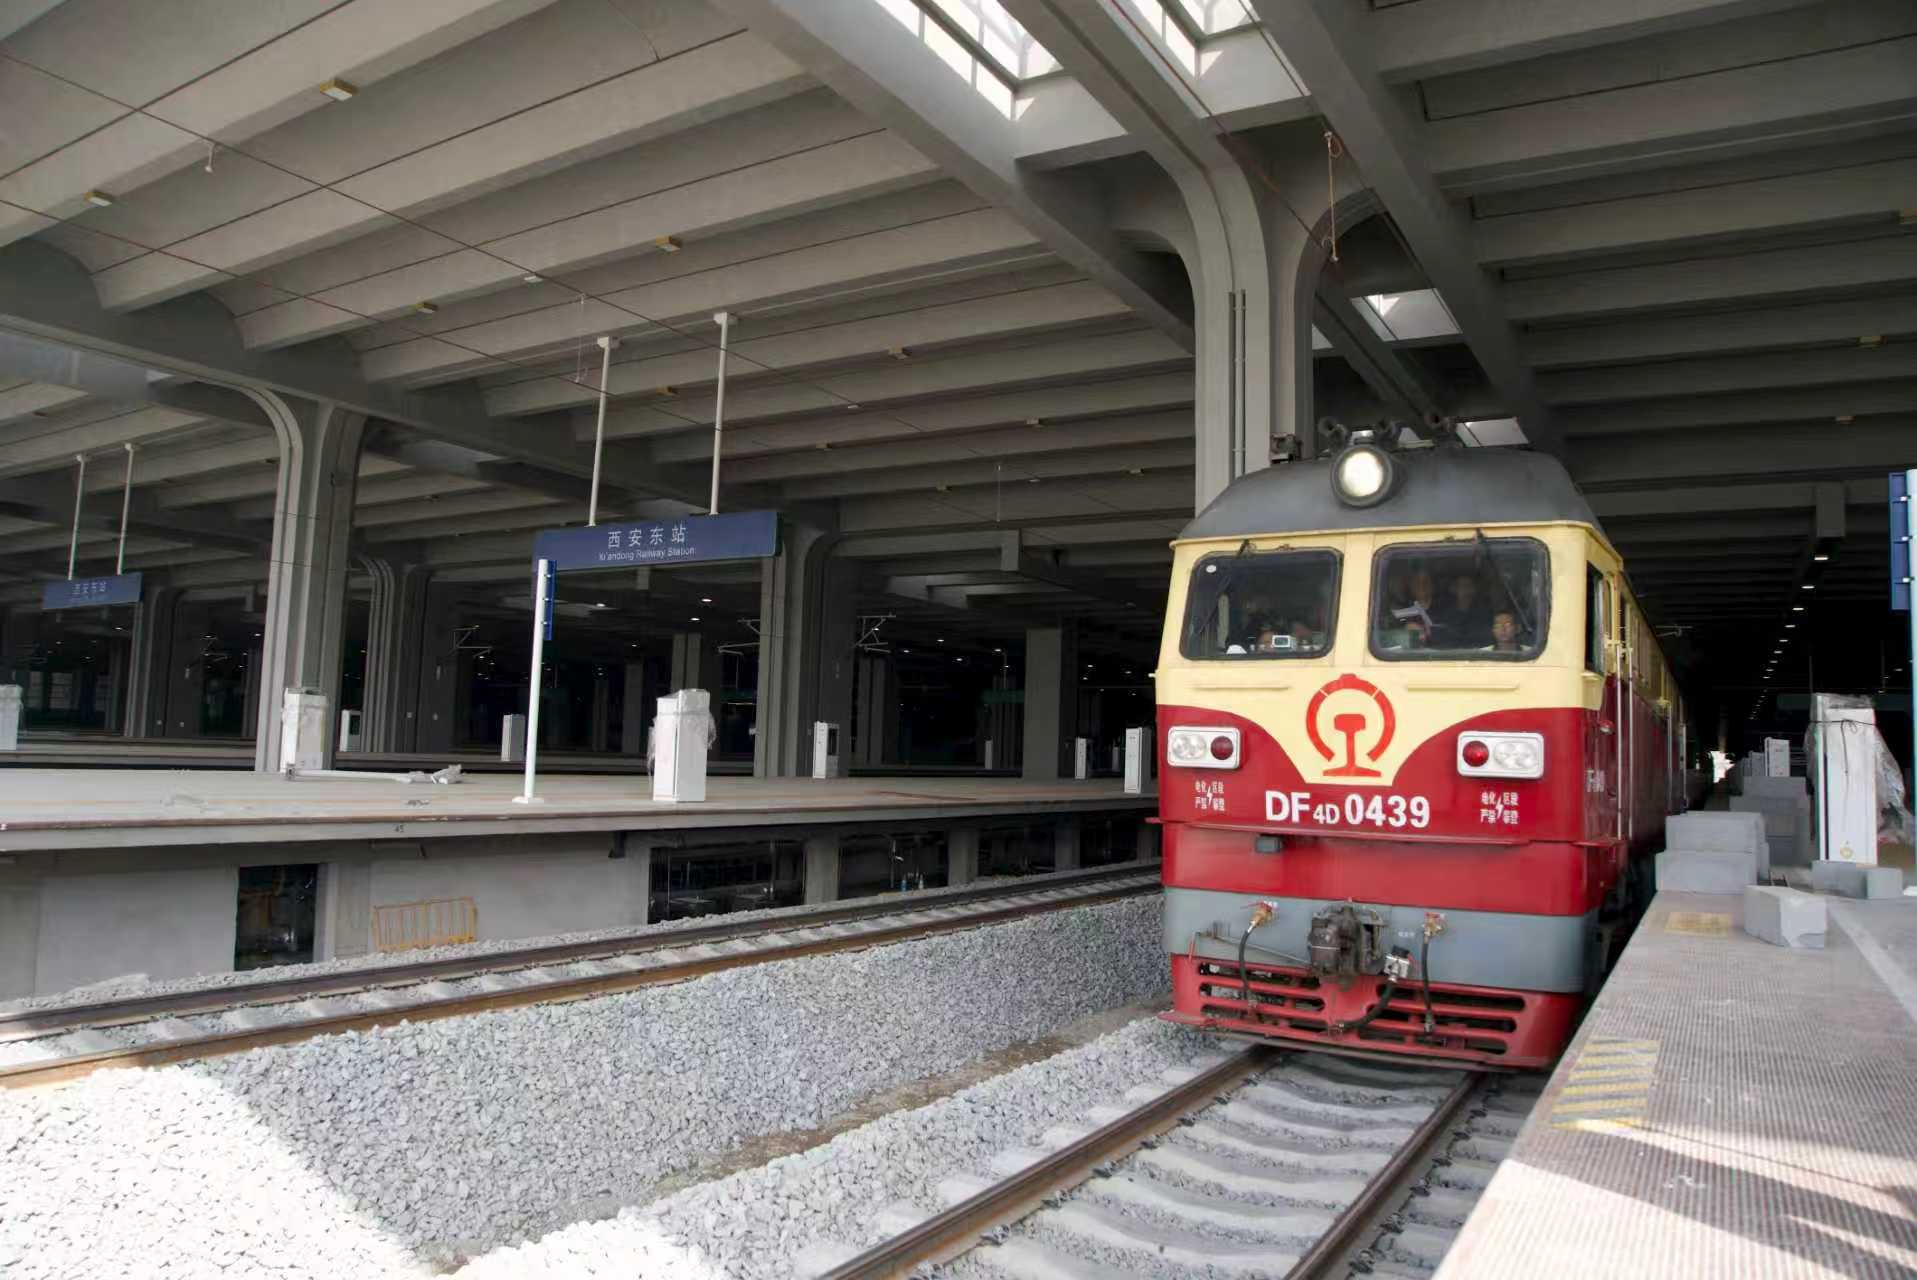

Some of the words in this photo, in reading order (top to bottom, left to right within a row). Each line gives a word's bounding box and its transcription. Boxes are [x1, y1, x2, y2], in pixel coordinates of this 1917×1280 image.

[607, 524, 686, 548] 西安东站
[636, 548, 666, 559] Railway
[667, 546, 695, 557] Station
[1344, 794, 1430, 828] 0439
